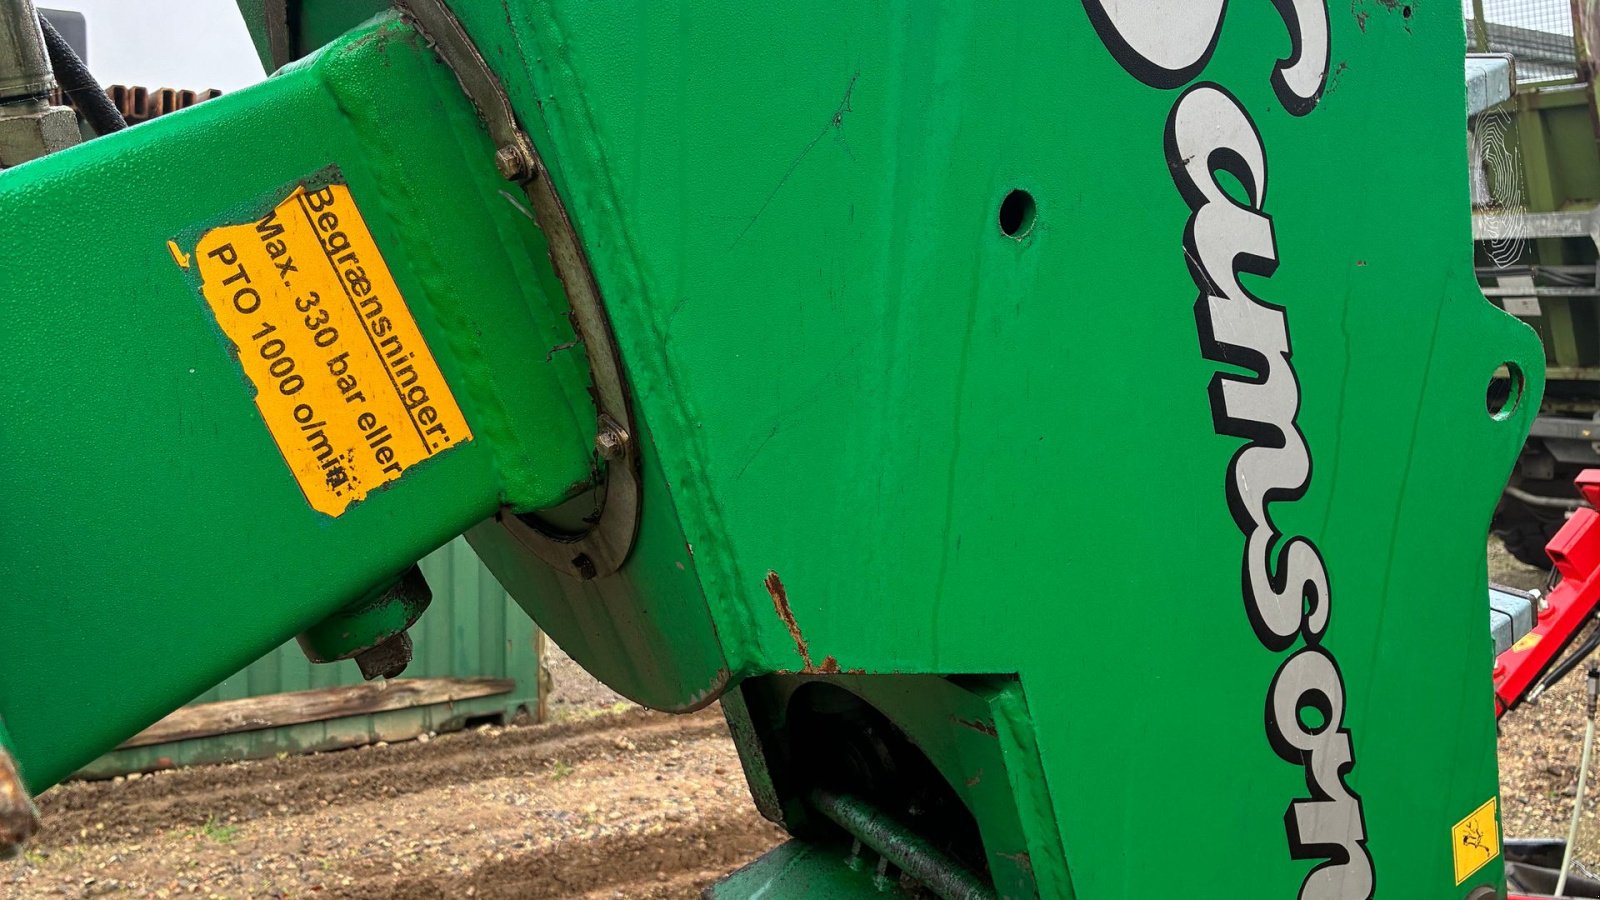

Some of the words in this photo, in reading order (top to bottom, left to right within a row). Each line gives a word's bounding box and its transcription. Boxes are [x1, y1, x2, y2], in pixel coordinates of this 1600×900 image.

[207, 242, 262, 315] PTO
[251, 321, 305, 396] 1000
[255, 210, 299, 289] Max.
[295, 291, 339, 348] 330
[327, 351, 367, 405] bar
[357, 411, 403, 475] eller
[304, 186, 451, 449] Begrænsninger:
